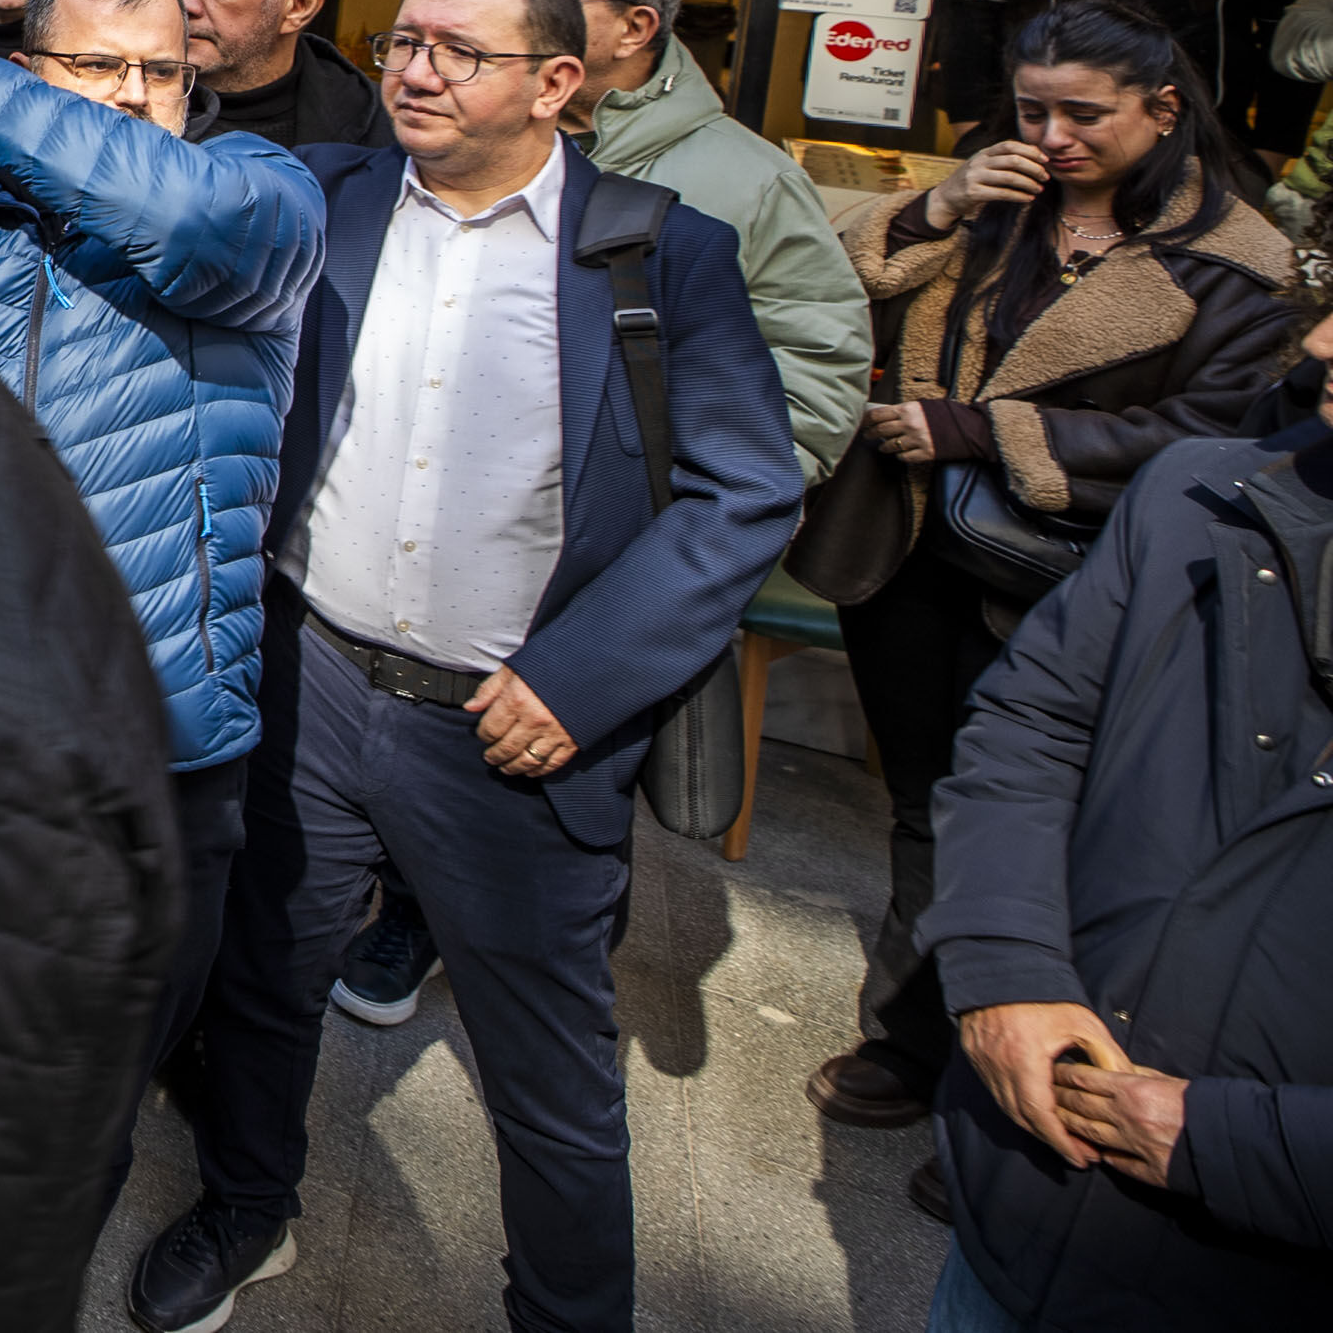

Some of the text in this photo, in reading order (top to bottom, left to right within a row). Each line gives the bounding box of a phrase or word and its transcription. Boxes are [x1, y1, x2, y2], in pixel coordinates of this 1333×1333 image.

[826, 30, 912, 53] Edenred
[839, 72, 905, 87] Restaurant
[872, 66, 906, 78] Ticket
